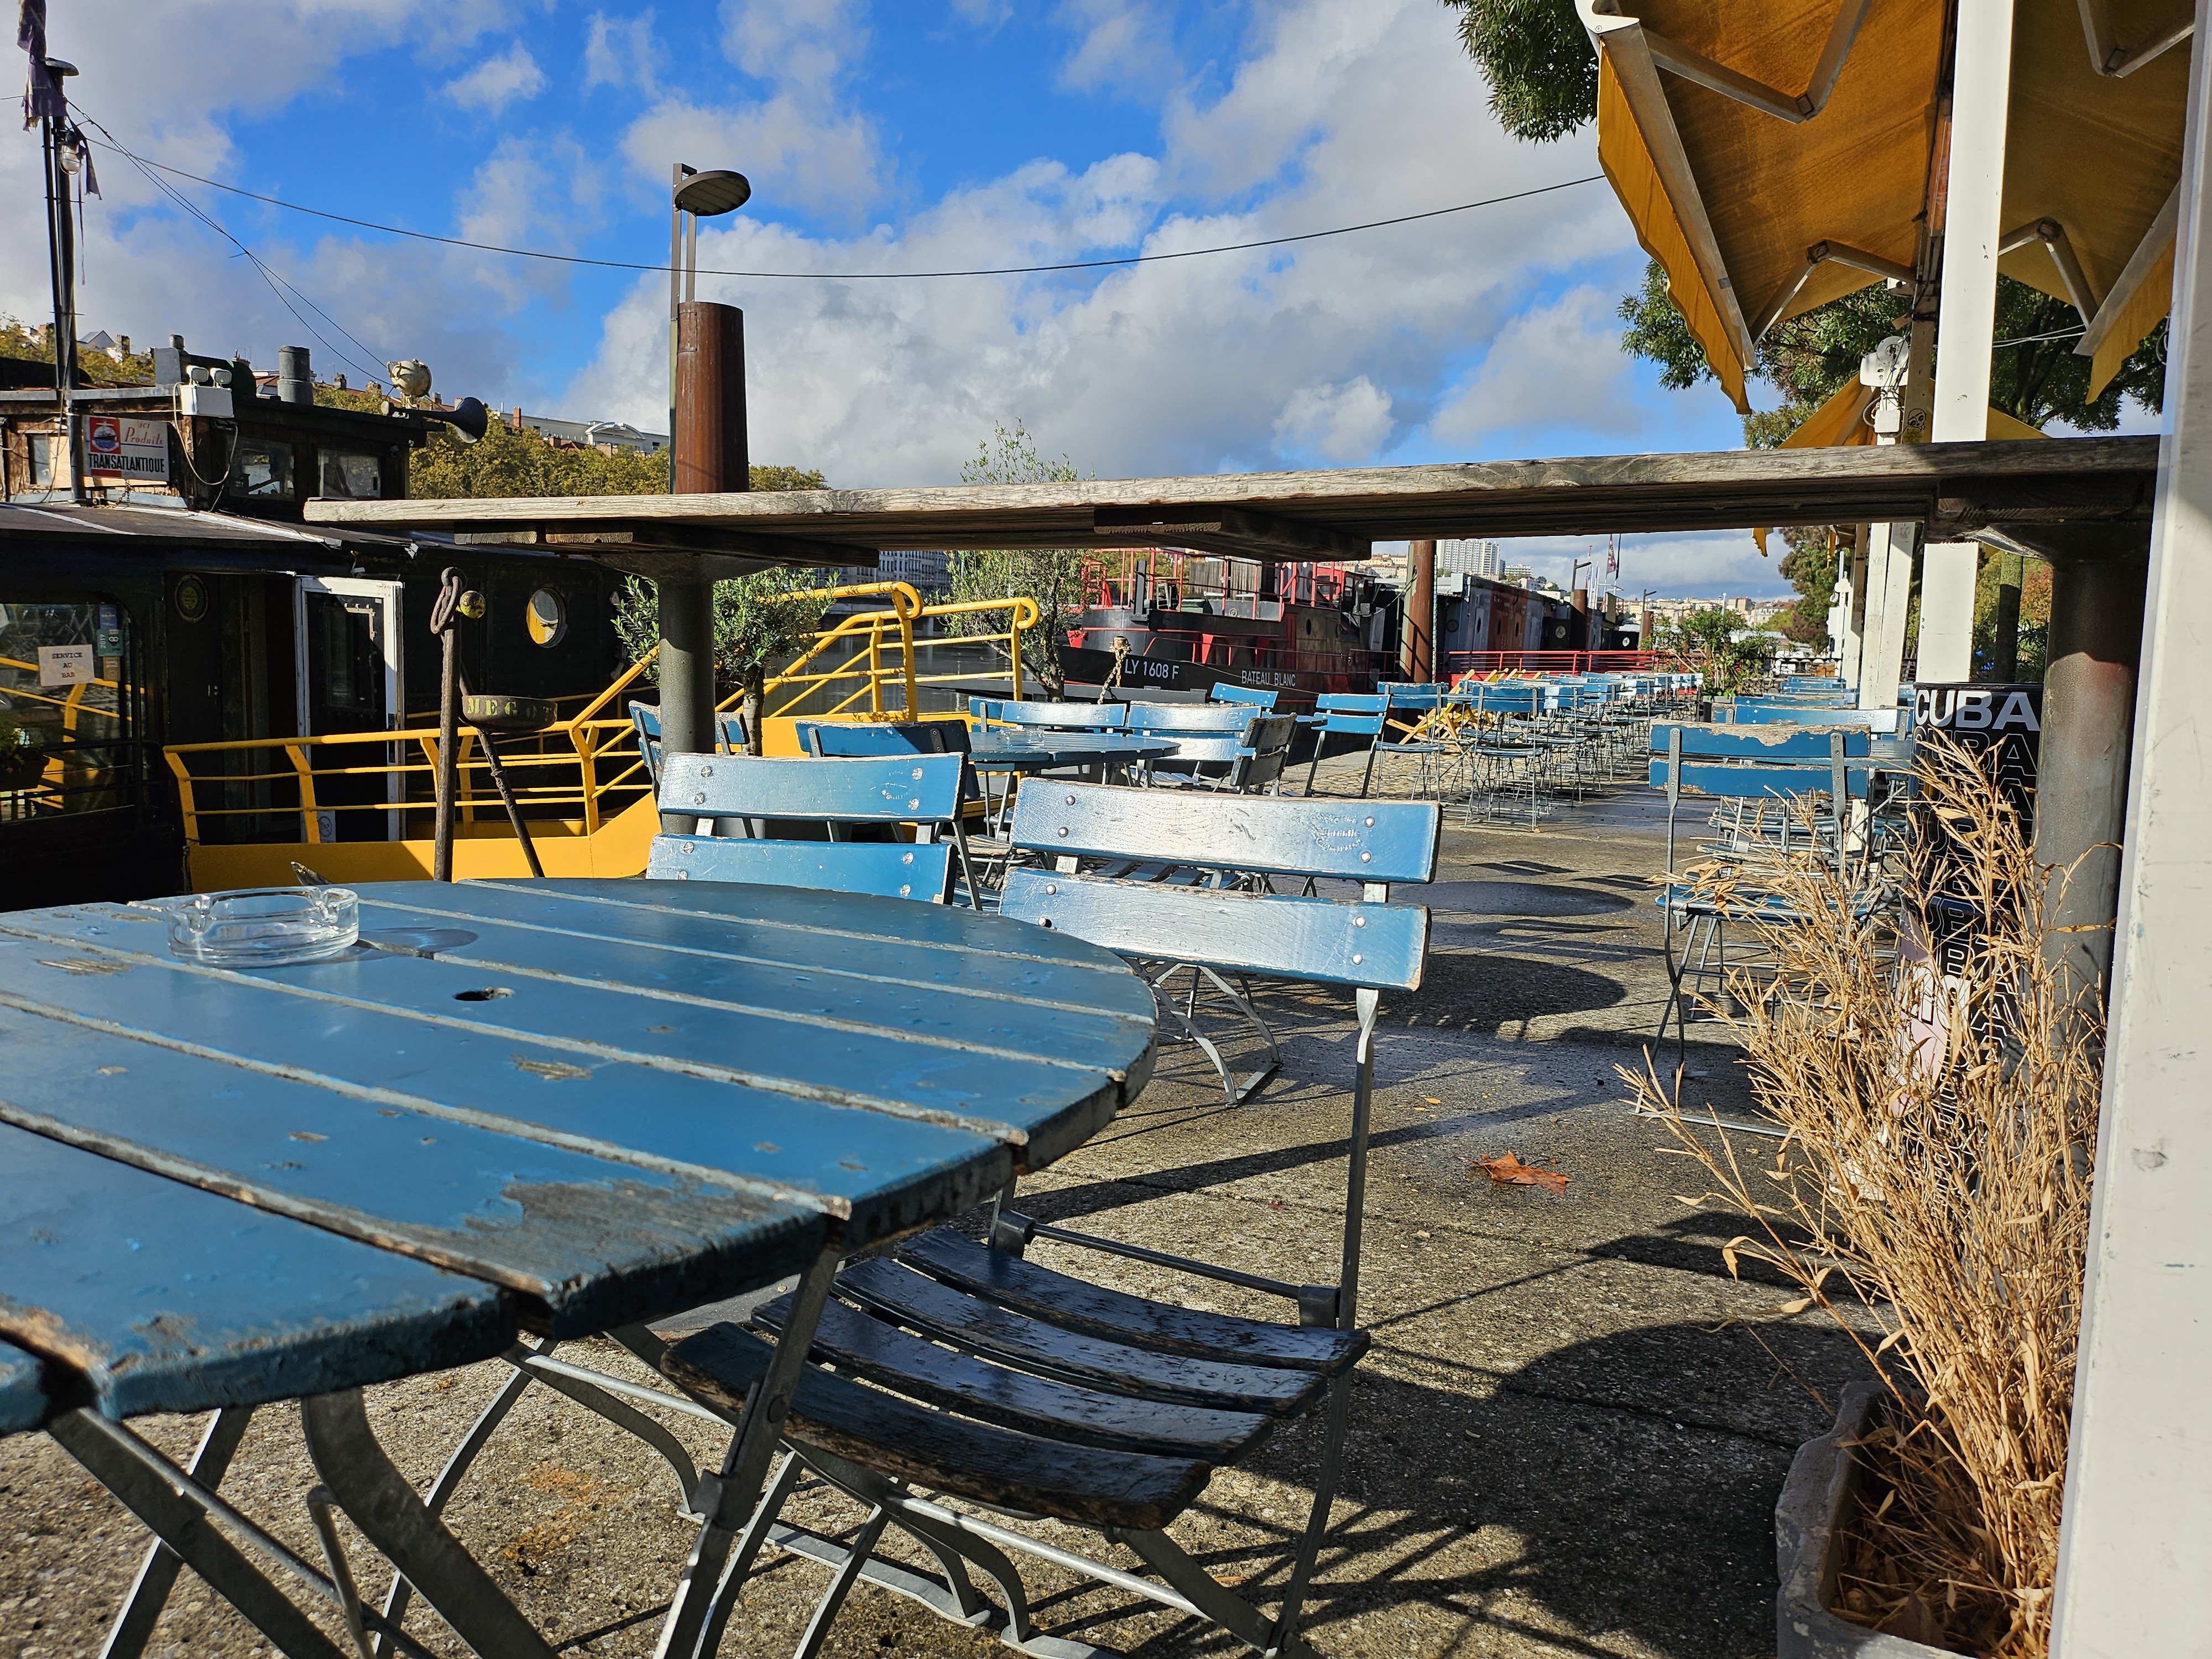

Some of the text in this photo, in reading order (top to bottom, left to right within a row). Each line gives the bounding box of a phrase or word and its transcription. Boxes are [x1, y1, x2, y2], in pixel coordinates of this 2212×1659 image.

[125, 427, 163, 445] Produits
[88, 453, 165, 473] TRANSATLANTIQUE
[1125, 659, 1180, 680] LY 1608 F
[1241, 670, 1296, 687] BATEAU BLANC
[1915, 690, 2041, 731] CUBA
